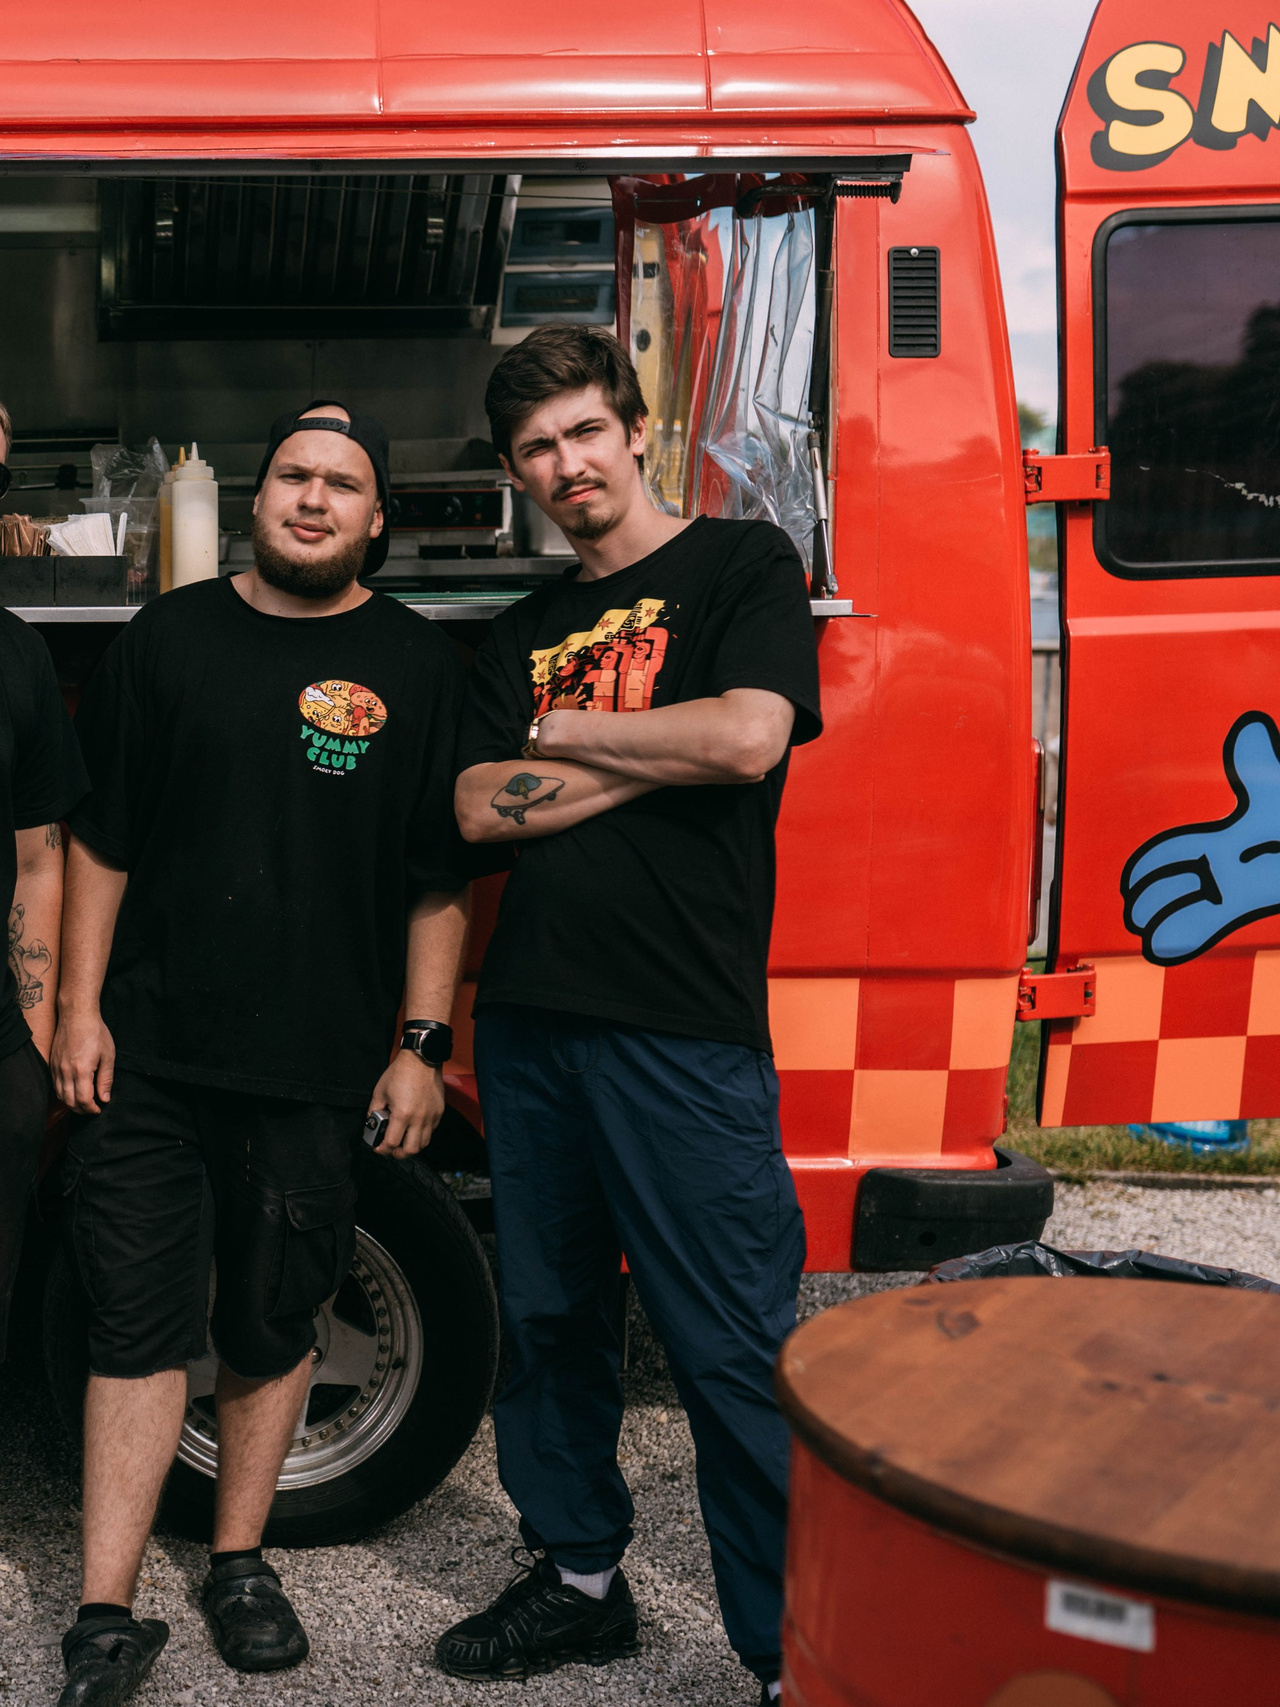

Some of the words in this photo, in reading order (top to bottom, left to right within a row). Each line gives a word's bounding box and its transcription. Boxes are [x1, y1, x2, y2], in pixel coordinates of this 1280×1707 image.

[300, 724, 370, 754] YUMMY
[306, 746, 356, 770] CLUB
[313, 765, 332, 774] SMOKY
